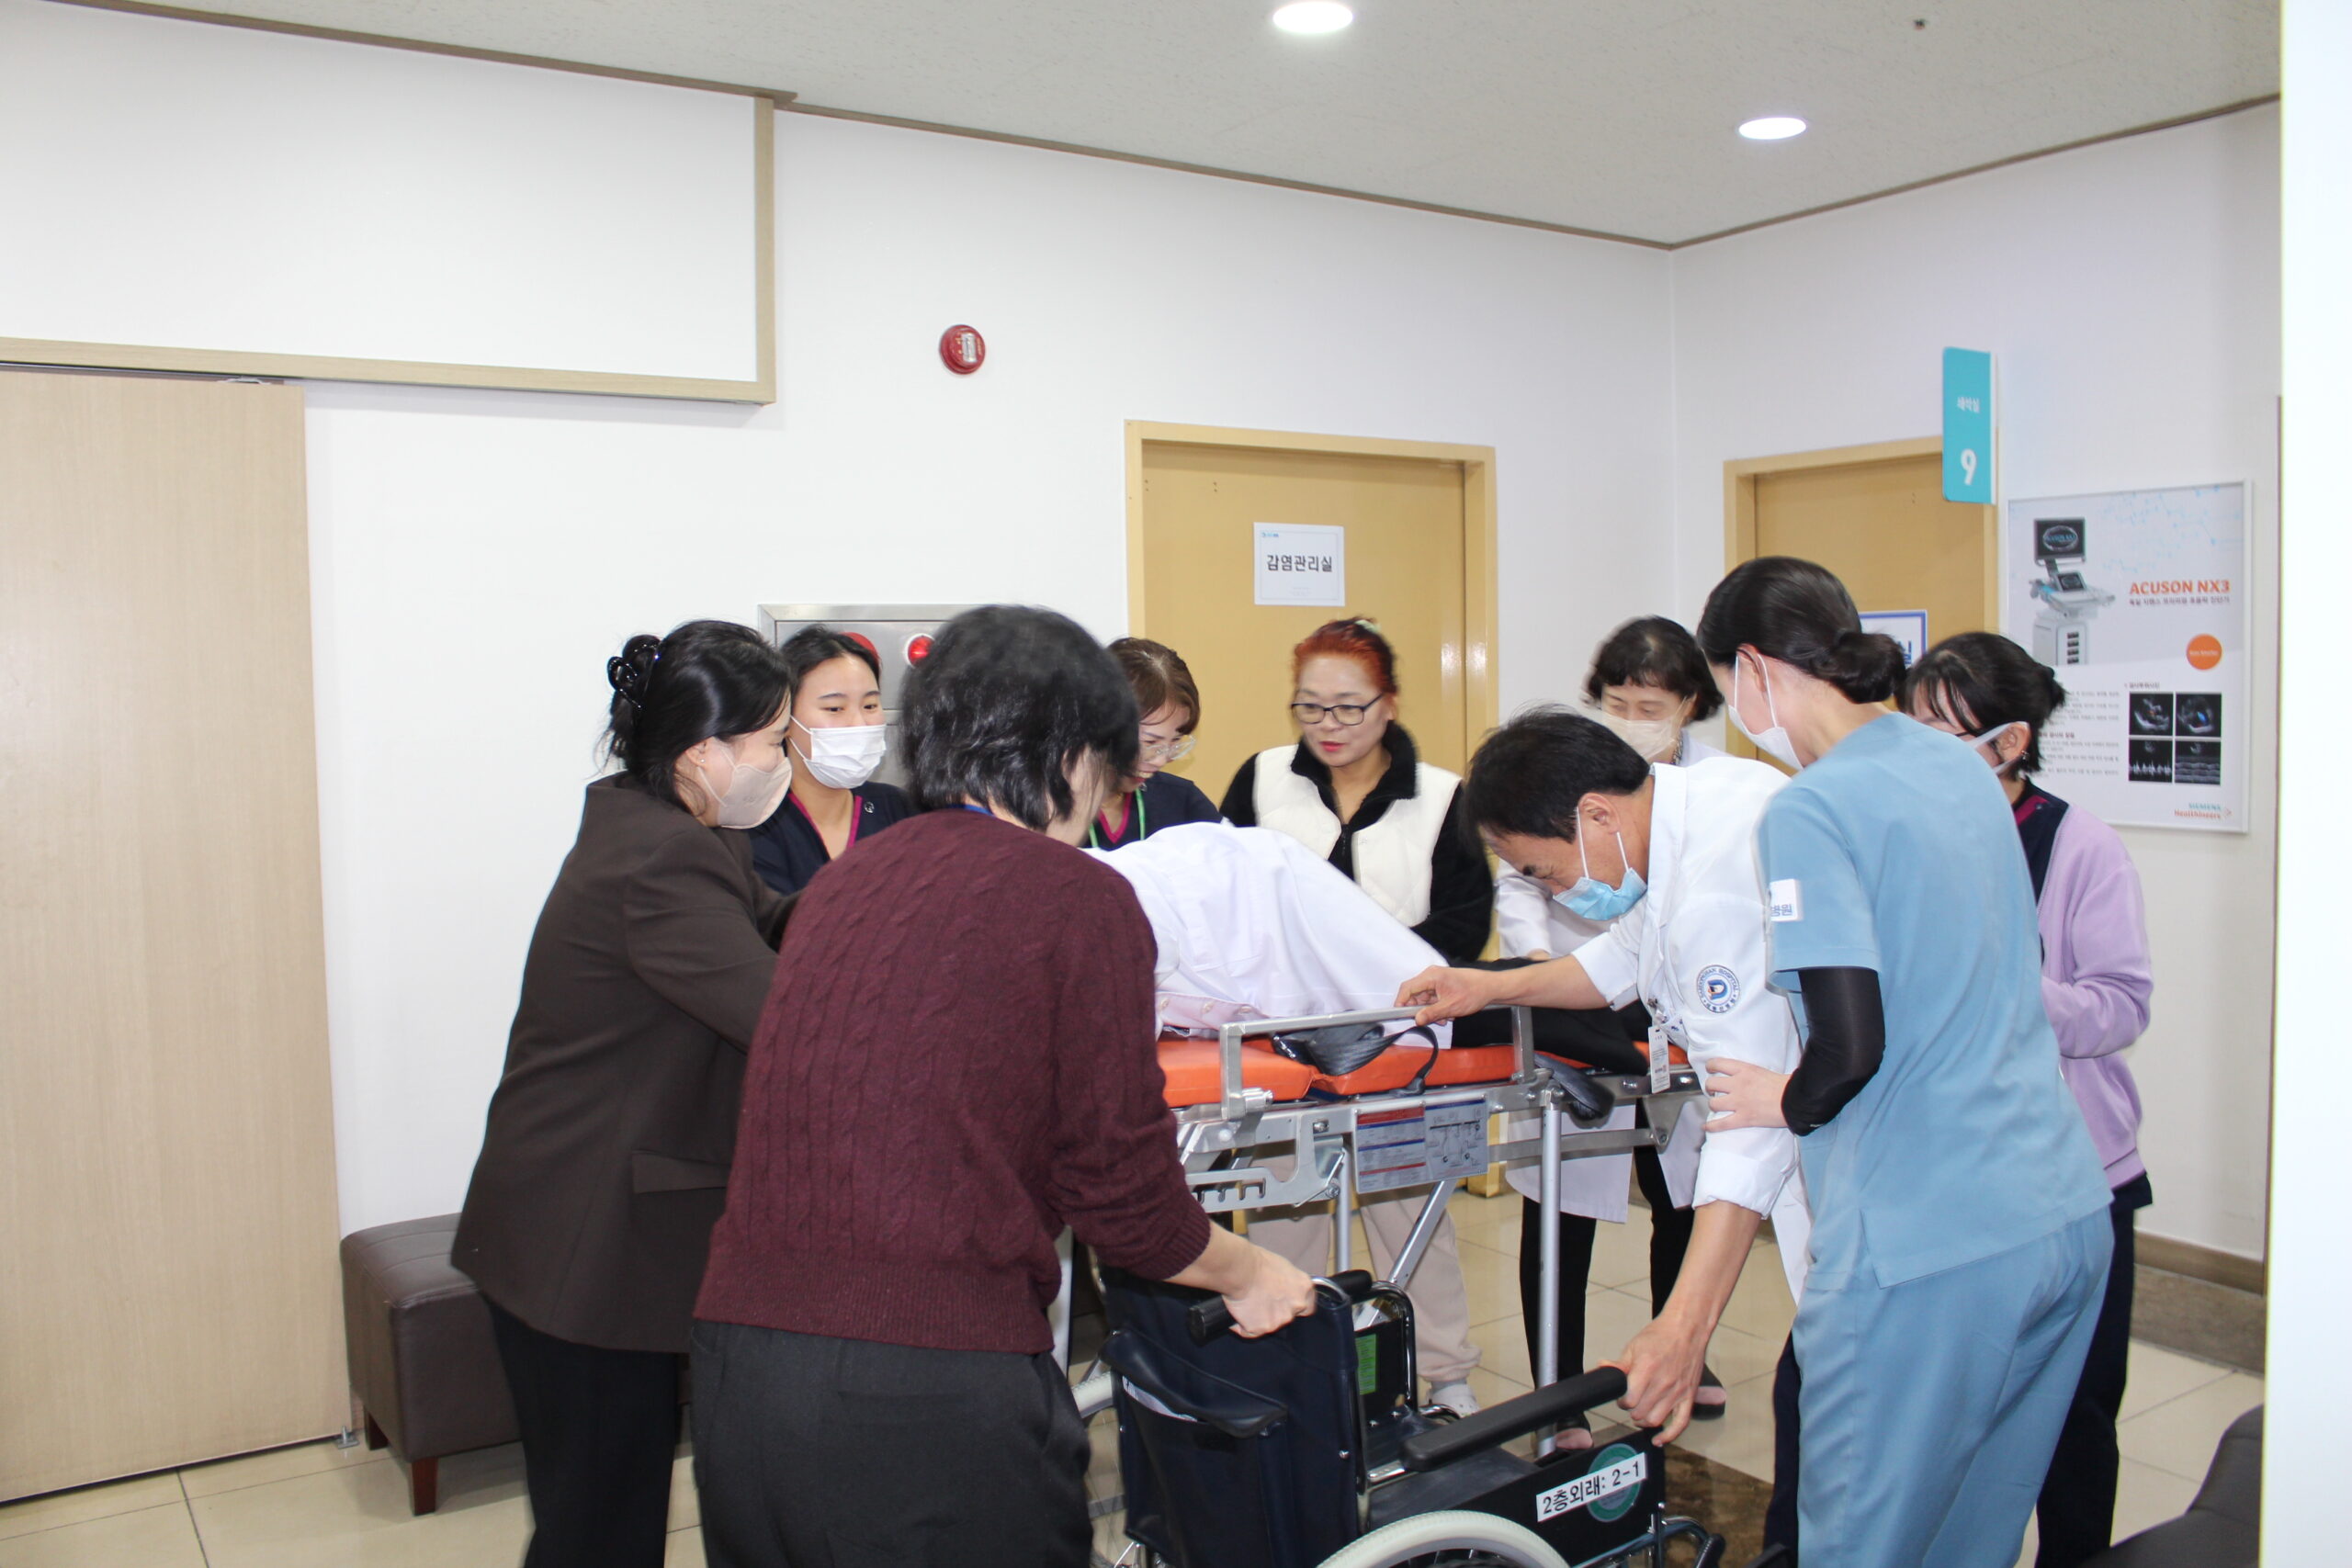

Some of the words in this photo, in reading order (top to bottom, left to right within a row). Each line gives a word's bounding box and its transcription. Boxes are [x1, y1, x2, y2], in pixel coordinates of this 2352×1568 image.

[1961, 448, 1977, 485] 9
[1267, 554, 1332, 572] 감염관리실
[2130, 581, 2193, 595] ACUSON
[2197, 580, 2230, 593] NX3
[1543, 1474, 1605, 1514] 2층외래:
[1611, 1461, 1639, 1487] 2-1
